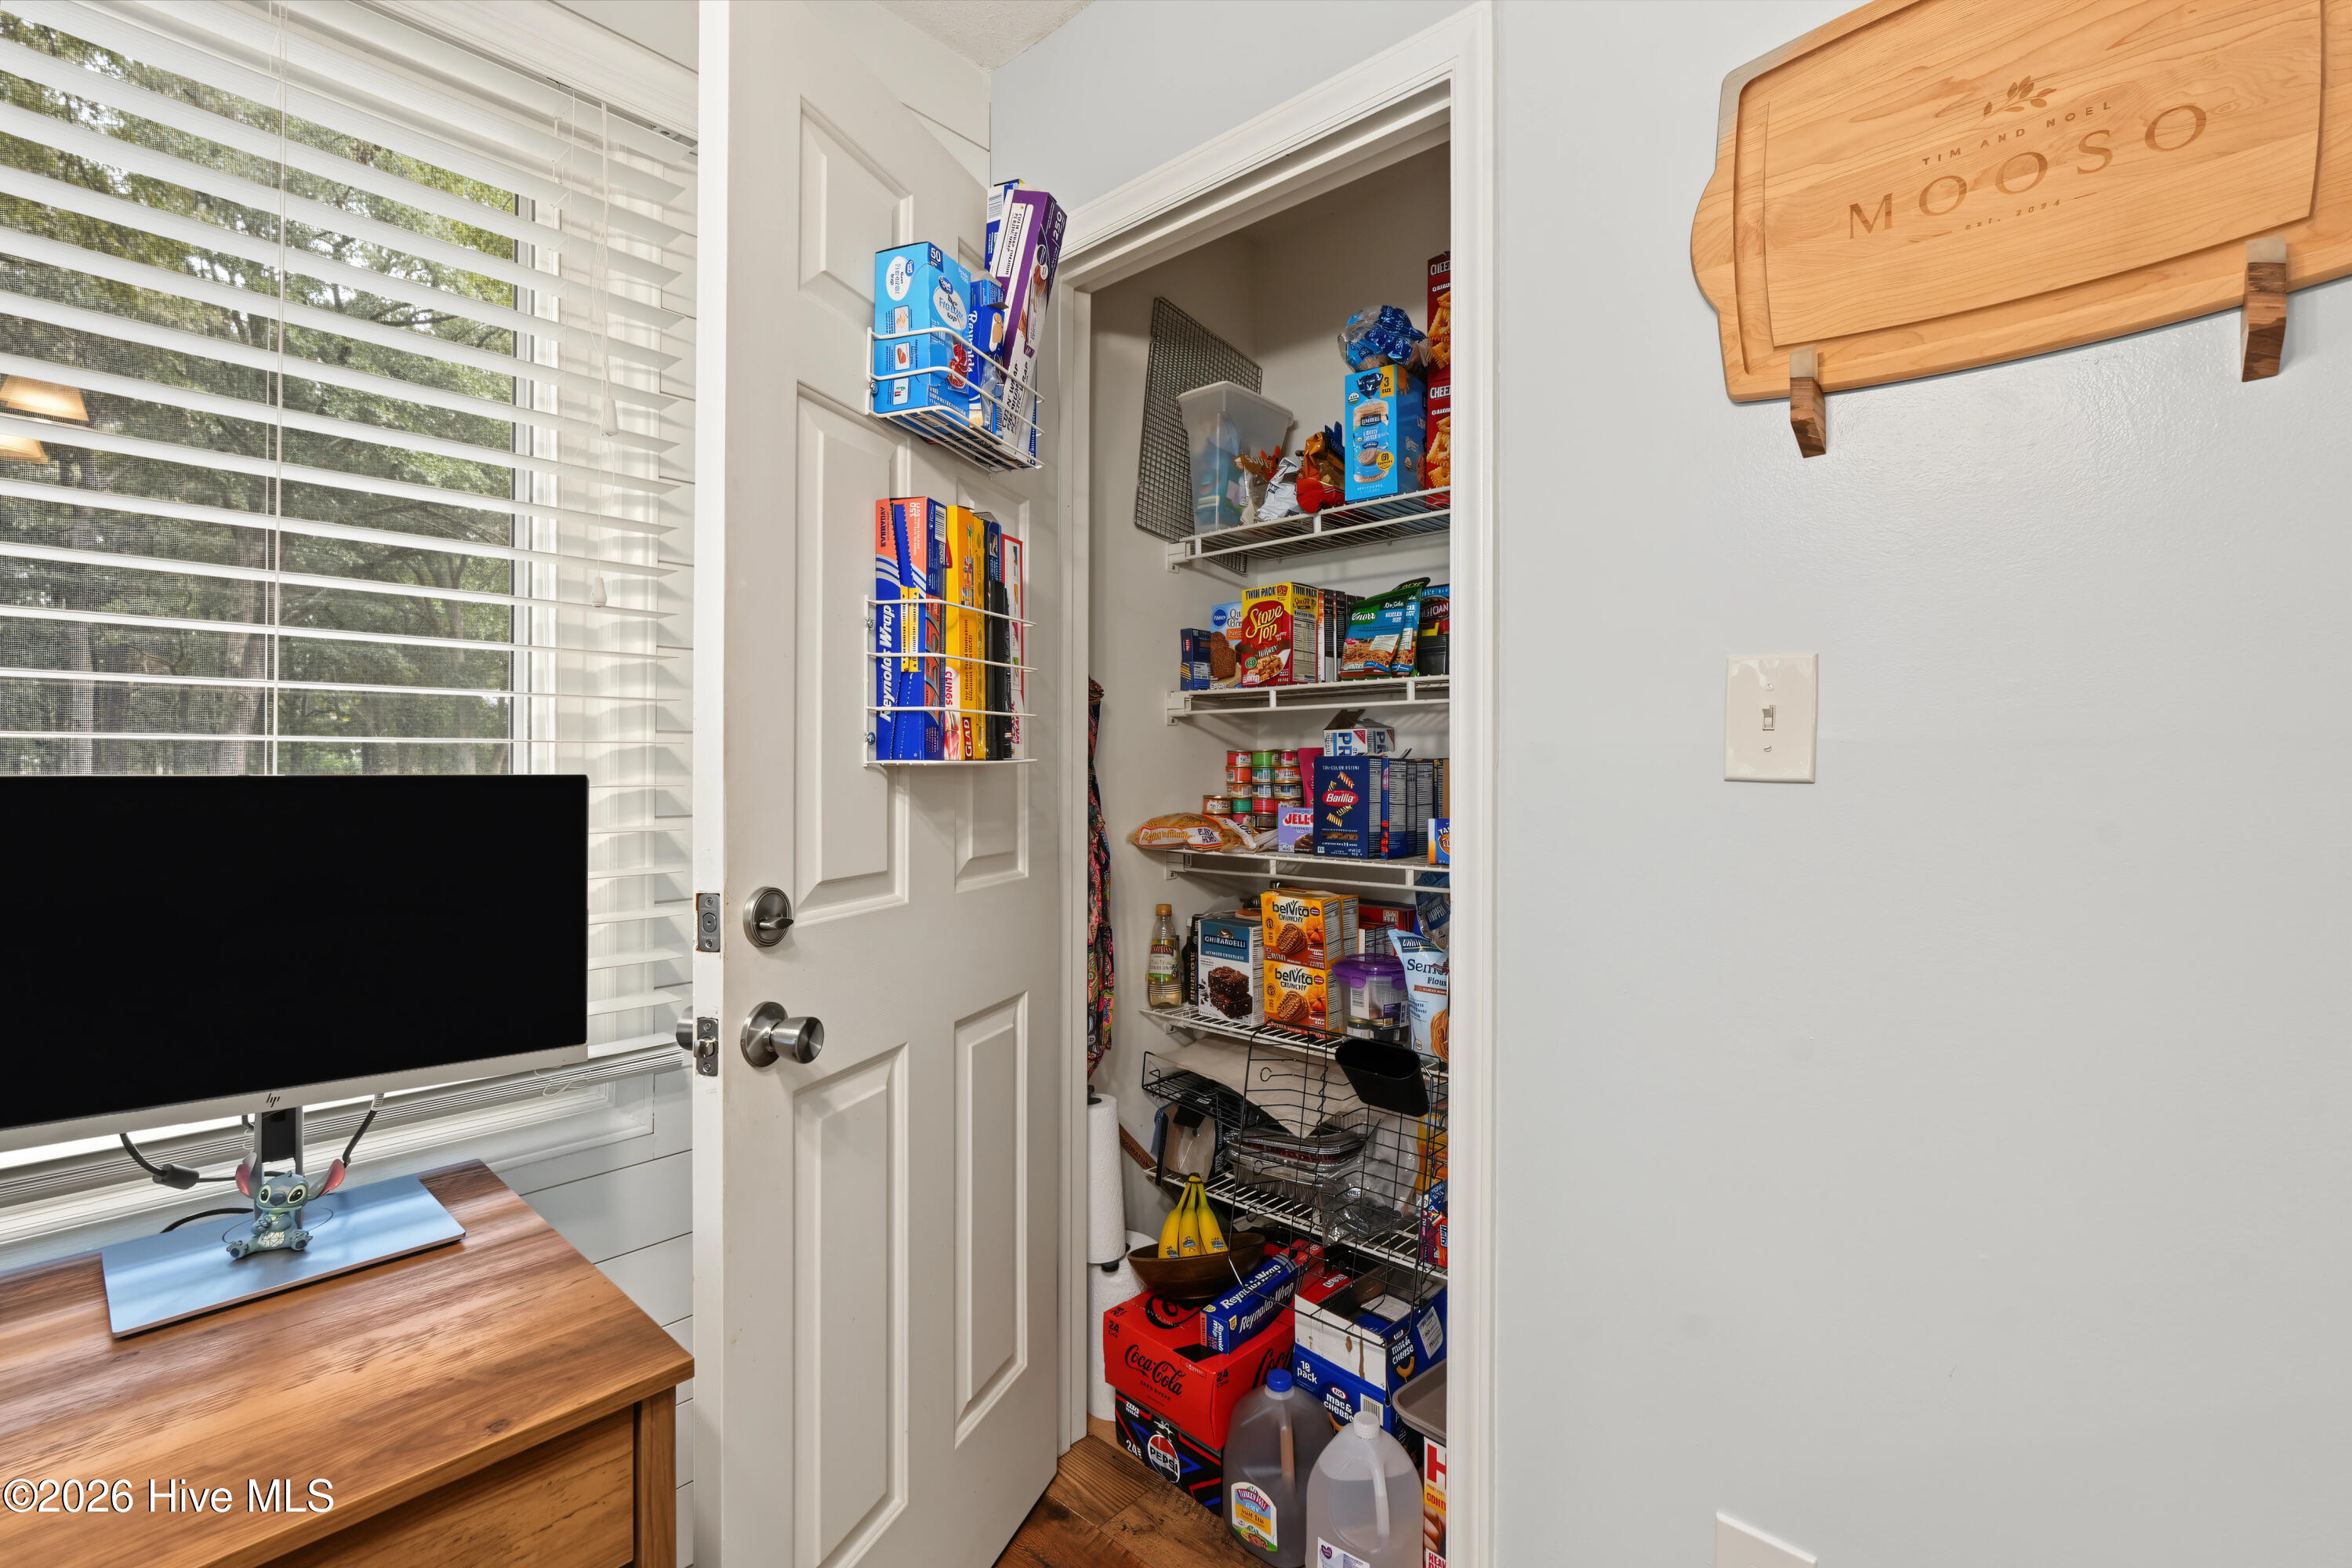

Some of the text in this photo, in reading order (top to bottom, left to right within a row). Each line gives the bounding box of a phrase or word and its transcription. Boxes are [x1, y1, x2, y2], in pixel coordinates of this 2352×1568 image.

[1922, 102, 2111, 165] TIM AND NOEL
[1849, 104, 2207, 238] MOOSO
[931, 247, 941, 263] 50
[879, 604, 895, 648] Wrap
[1246, 605, 1284, 638] Stove
[1258, 623, 1278, 644] Top
[964, 719, 973, 757] GLAD
[1326, 793, 1356, 804] Barilla
[1272, 900, 1309, 917] belVita
[1275, 968, 1313, 985] belVita
[1428, 977, 1446, 987] Flou
[267, 1092, 281, 1108] hp
[1297, 1367, 1318, 1385] pack
[1149, 1446, 1179, 1474] PEPSI
